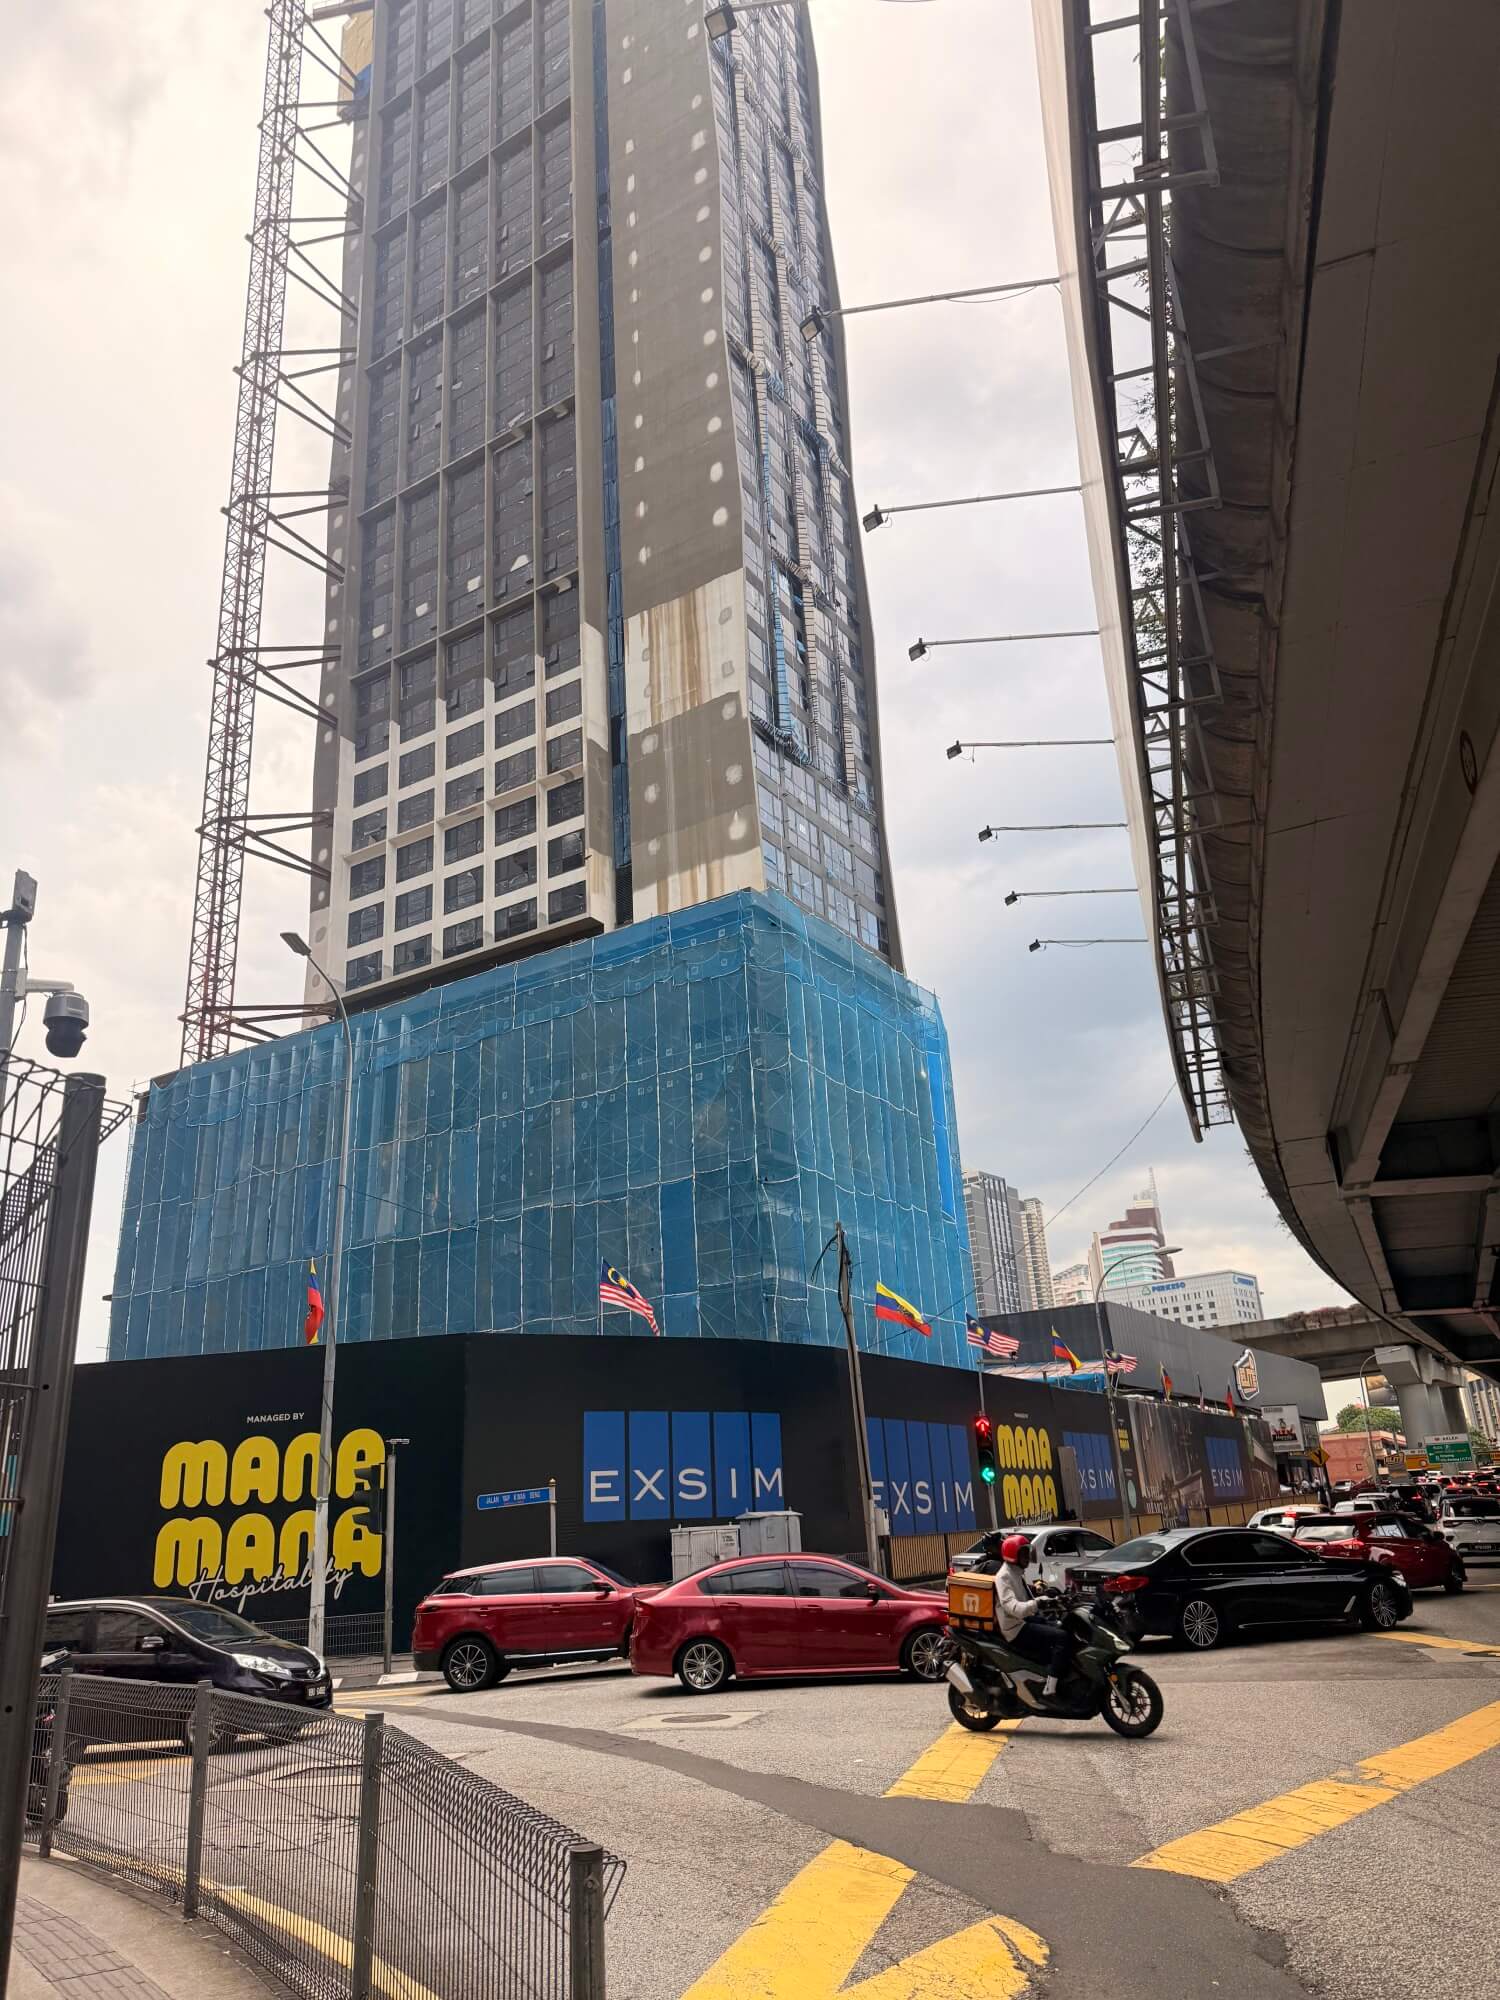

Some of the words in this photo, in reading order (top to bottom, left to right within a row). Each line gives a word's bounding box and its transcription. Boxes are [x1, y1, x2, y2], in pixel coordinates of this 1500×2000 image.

[246, 1413, 291, 1424] MANAGED
[292, 1412, 305, 1421] BY
[159, 1428, 386, 1510] MANA
[997, 1424, 1053, 1471] MANA
[589, 1467, 784, 1504] EXSIM
[1002, 1474, 1059, 1520] MANA
[1079, 1468, 1116, 1489] XSIM
[1210, 1467, 1245, 1488] EXSIM
[152, 1506, 383, 1589] MANA
[189, 1555, 354, 1614] Hospitalty
